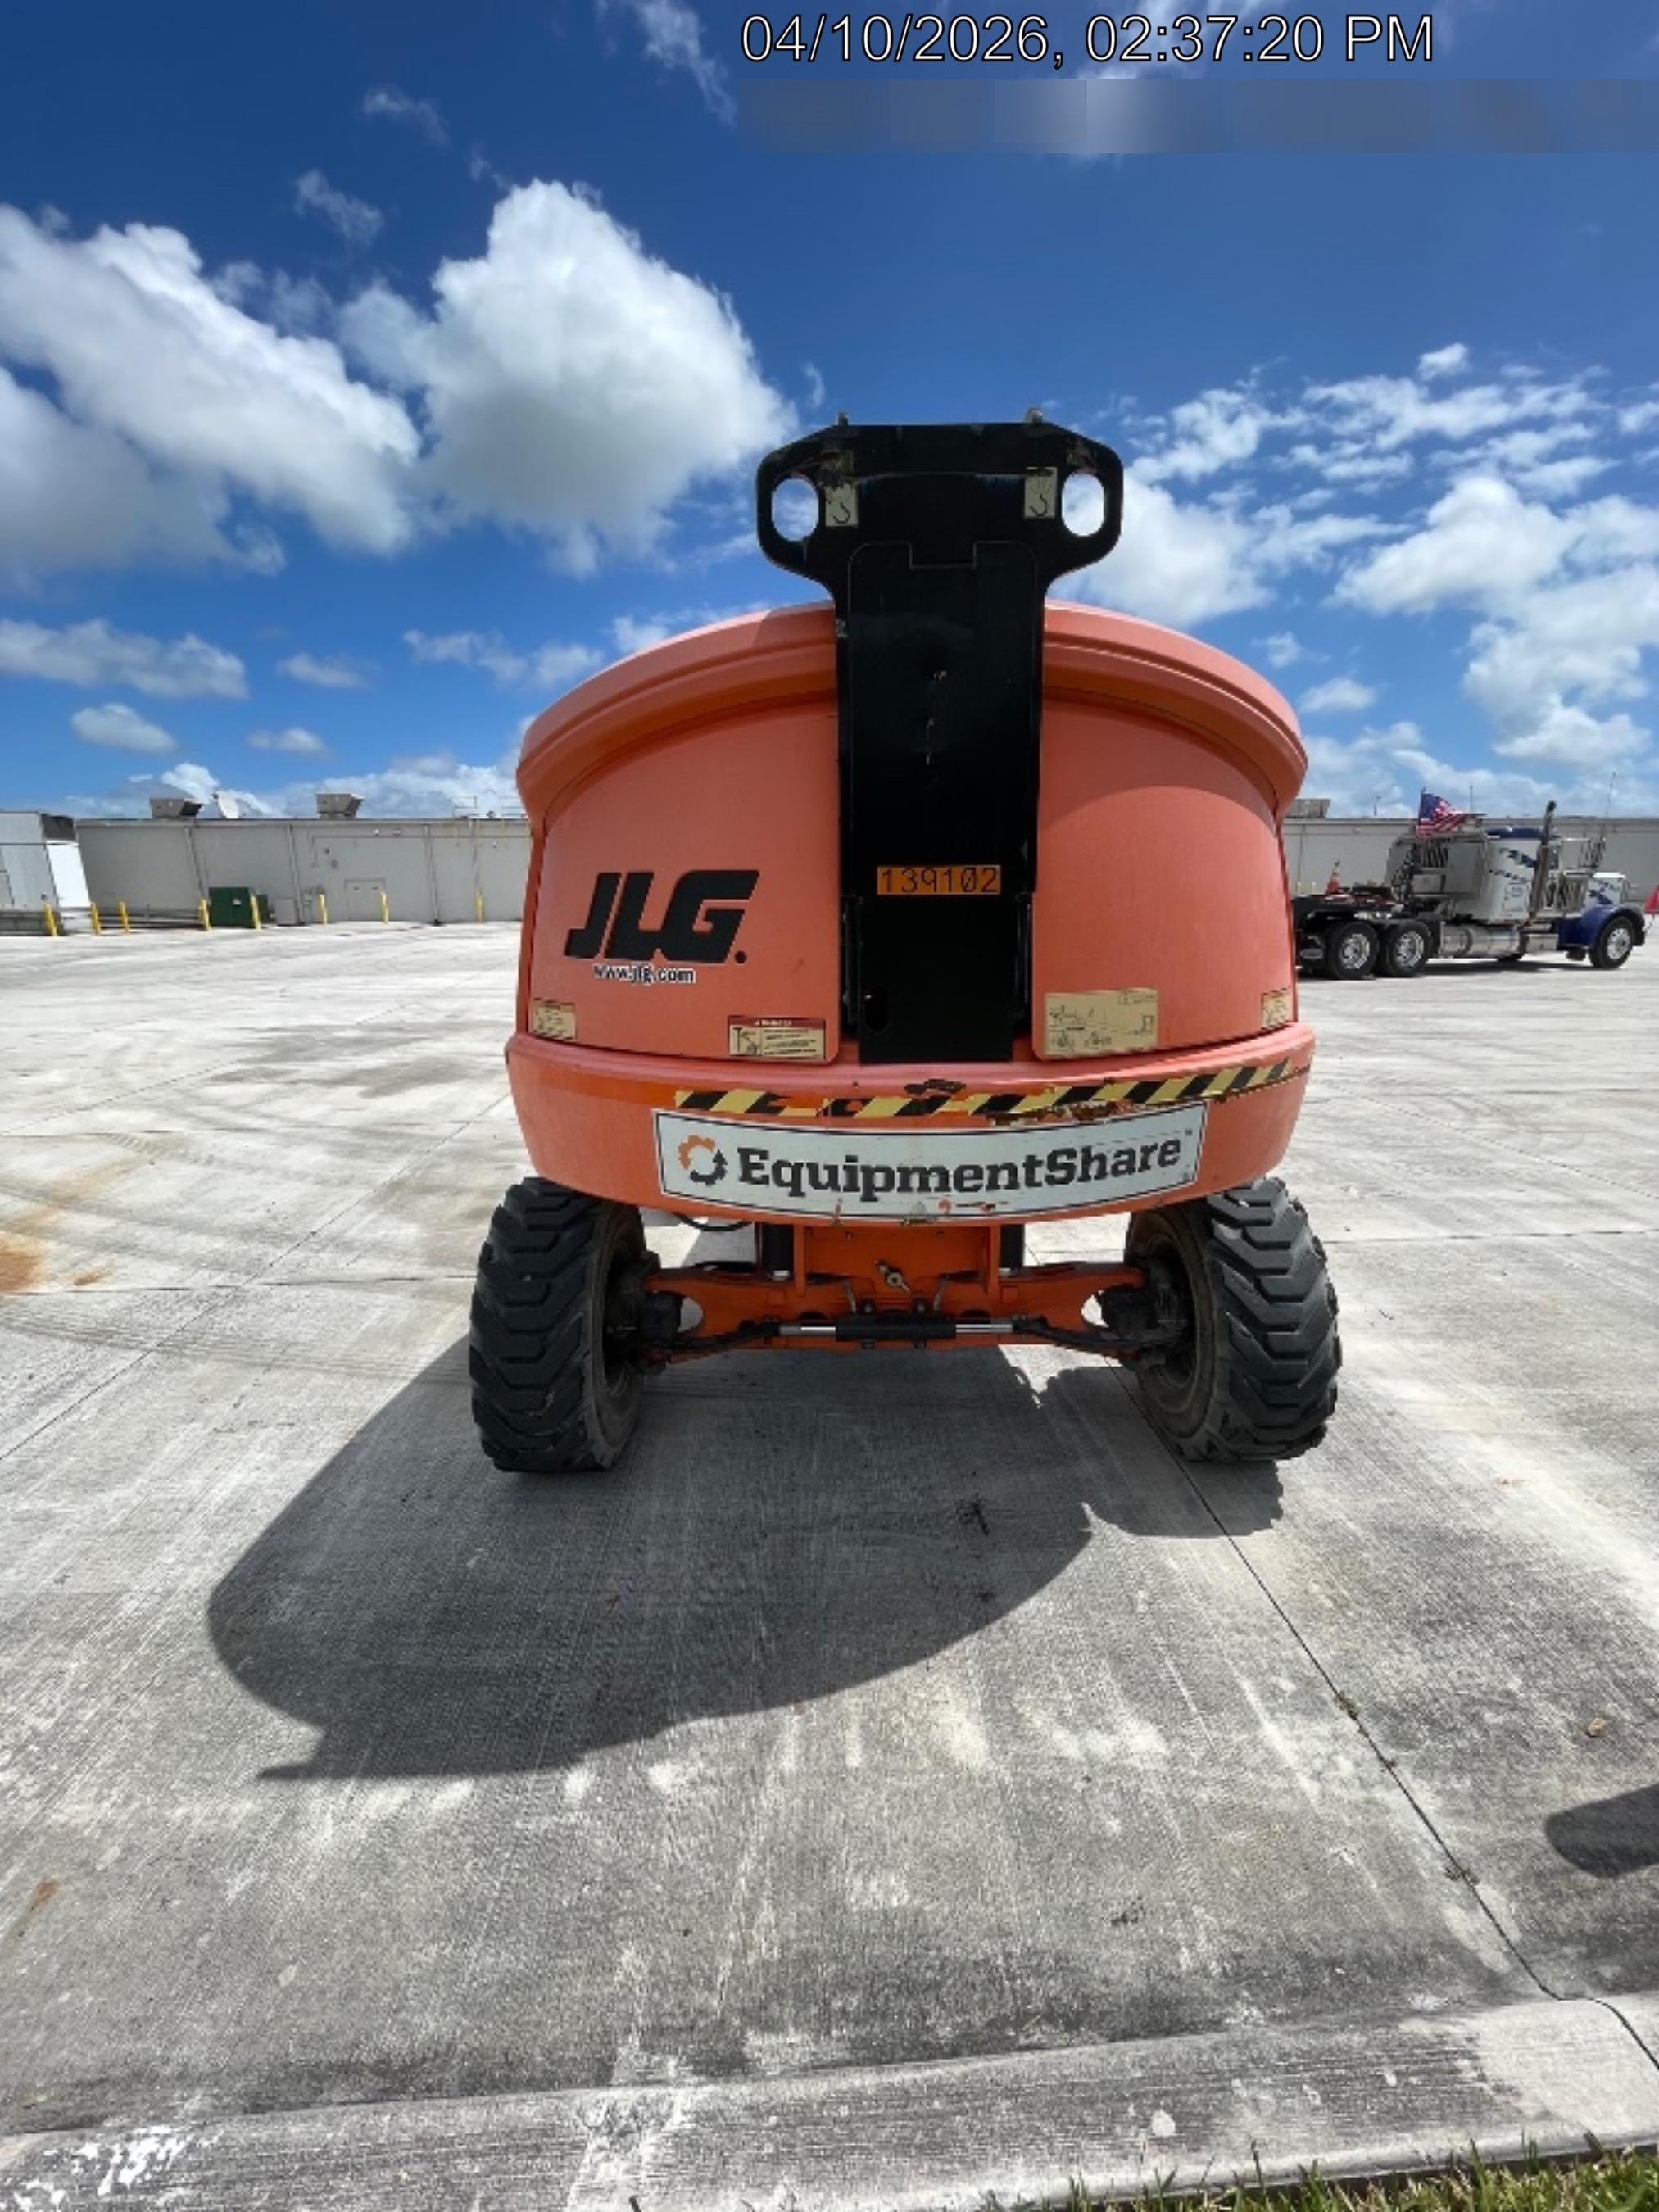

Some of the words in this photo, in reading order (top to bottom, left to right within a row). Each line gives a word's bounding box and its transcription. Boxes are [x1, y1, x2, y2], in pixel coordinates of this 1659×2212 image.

[882, 867, 997, 893] 139102
[564, 869, 760, 963] JLG
[593, 964, 695, 984] www.jlg.com
[737, 1137, 1181, 1202] EquipmentShare
